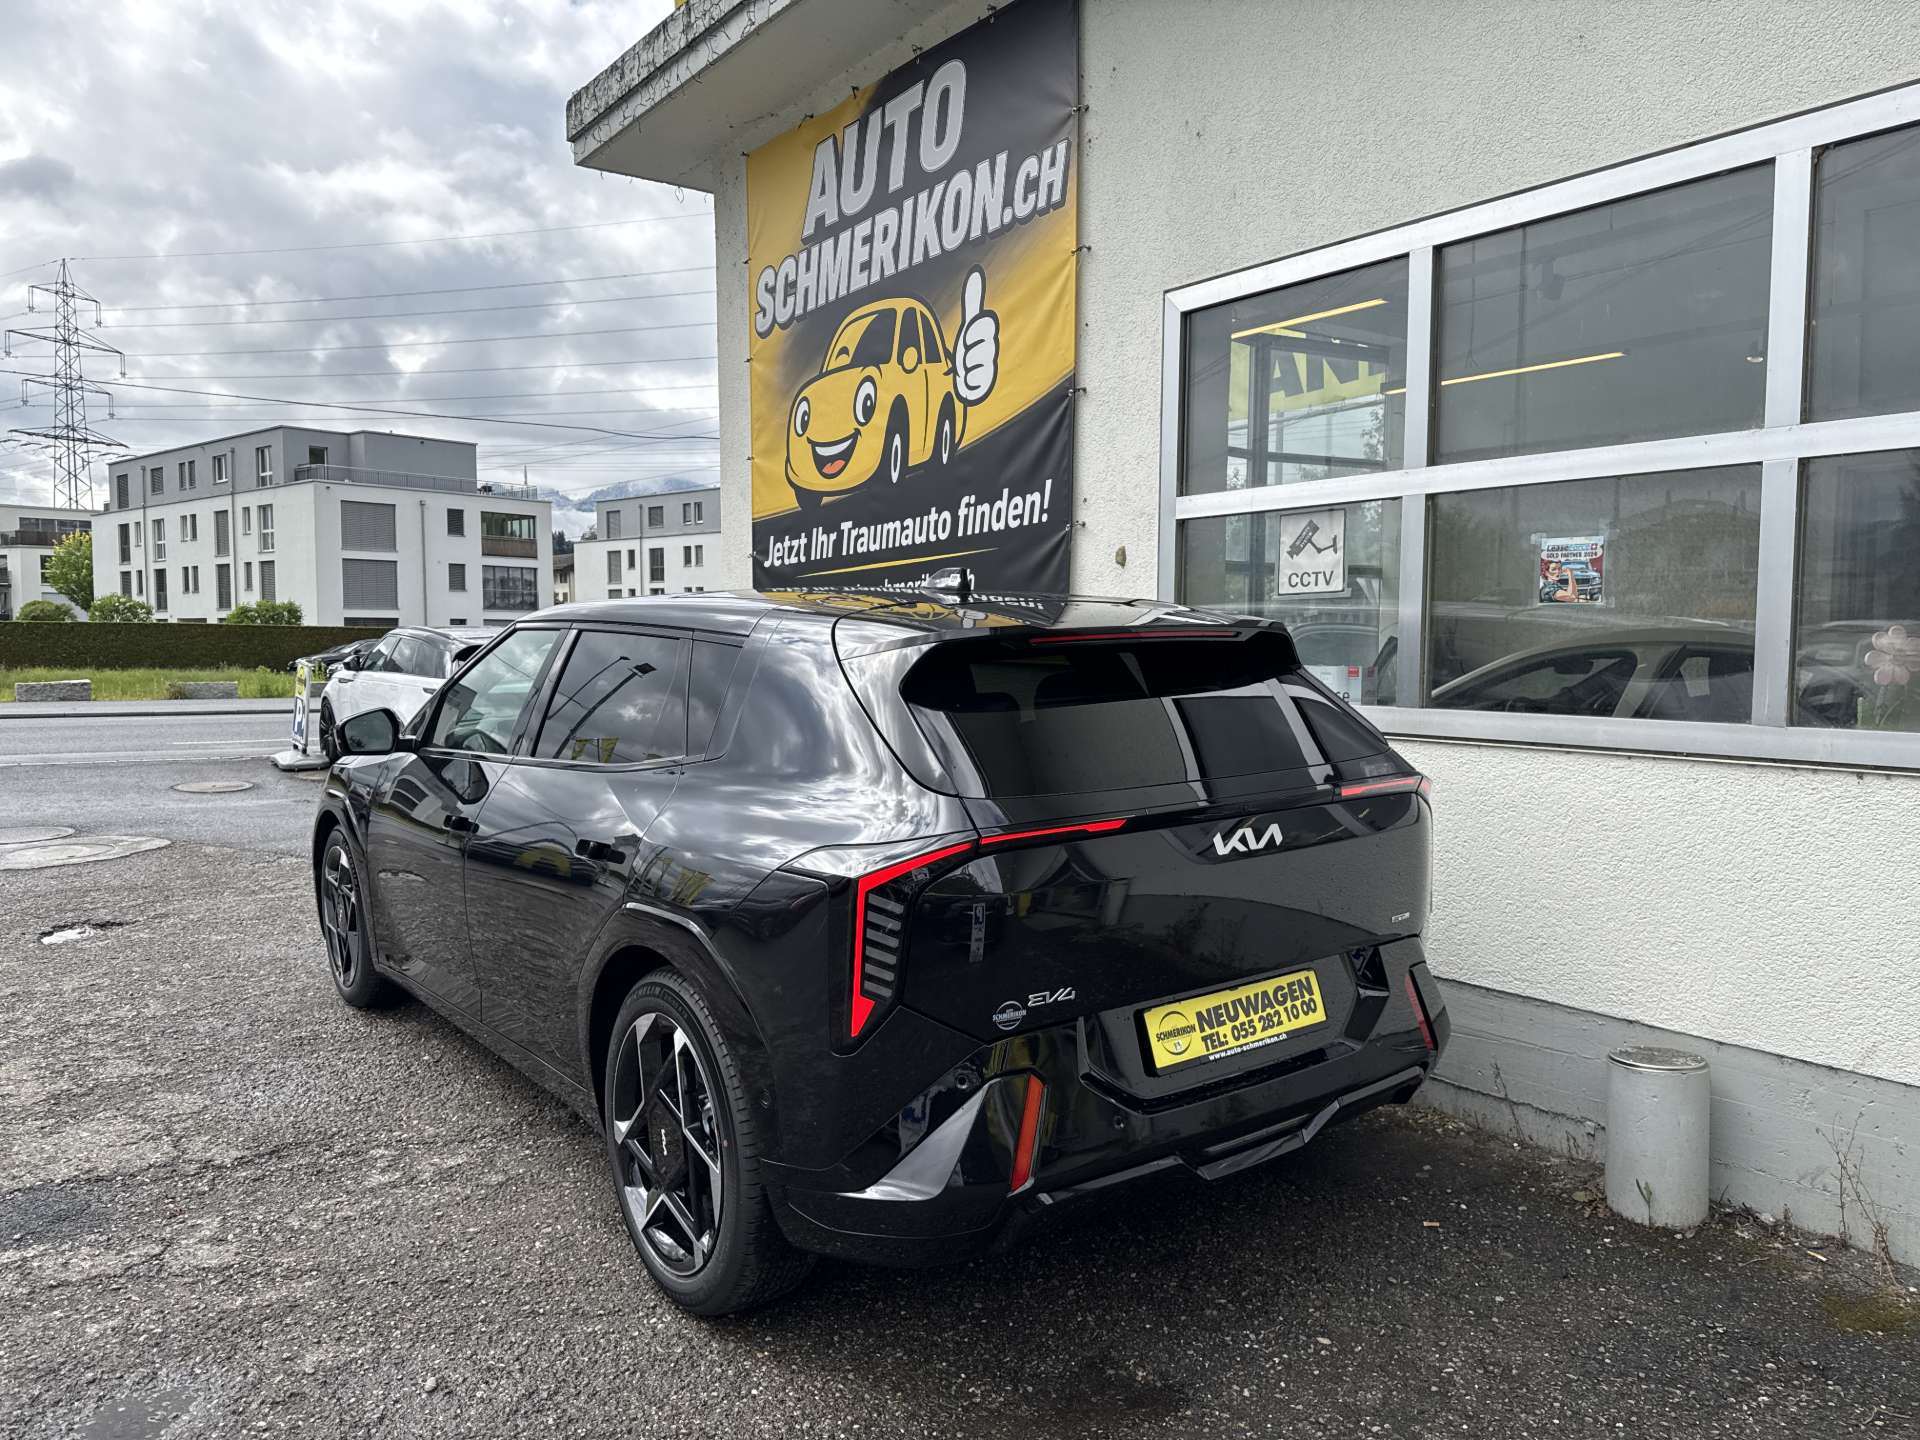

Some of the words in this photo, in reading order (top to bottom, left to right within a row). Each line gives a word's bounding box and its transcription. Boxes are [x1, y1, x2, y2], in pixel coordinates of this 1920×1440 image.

[802, 59, 967, 240] AUTO
[755, 139, 1070, 336] SCHMERIKON.CH
[764, 536, 807, 568] Jetzt
[811, 526, 837, 561] Ihr
[840, 506, 951, 557] Traumauto
[957, 479, 1053, 537] finden!
[1288, 570, 1334, 588] CCTV
[1213, 823, 1283, 856] KIA
[1027, 986, 1076, 1007] EV4
[1195, 976, 1315, 1033] NEUWAGEN
[1156, 1023, 1196, 1042] SCHMERIKON
[1201, 1032, 1229, 1052] TEL:
[1231, 1023, 1257, 1042] 055
[1258, 1011, 1283, 1032] 282
[1284, 1006, 1300, 1023] 10
[1299, 998, 1317, 1016] 00
[1208, 1032, 1288, 1061] www.auto-schmerikon.ch
